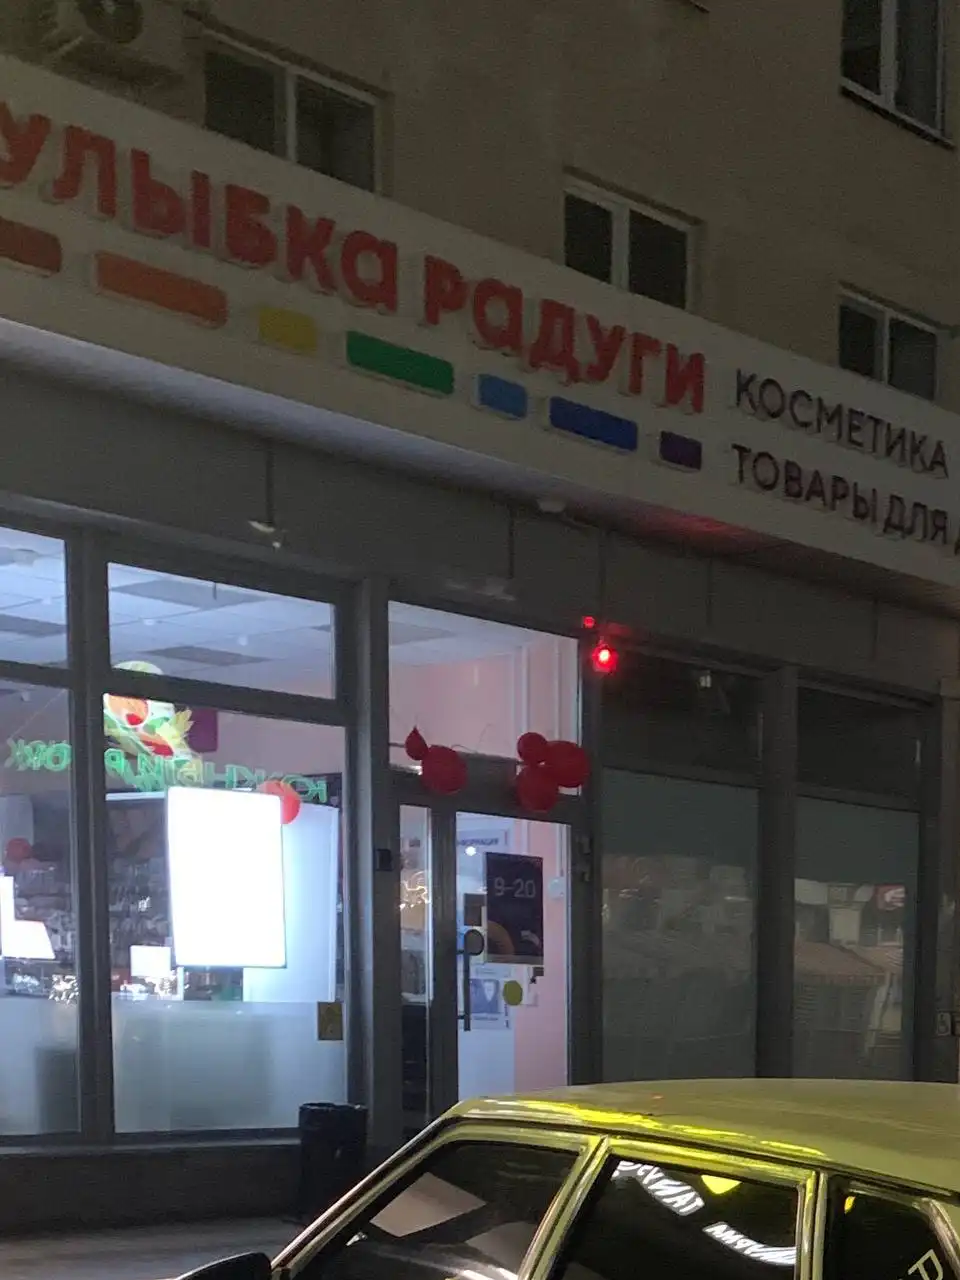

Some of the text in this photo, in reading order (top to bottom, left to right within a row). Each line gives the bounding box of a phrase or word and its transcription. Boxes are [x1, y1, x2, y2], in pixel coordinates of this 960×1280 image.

[735, 367, 950, 479] КОСМЕТИКА
[731, 443, 878, 522] ТОВАРЫ
[882, 494, 949, 546] ДЛЯ
[494, 876, 537, 898] 9-20
